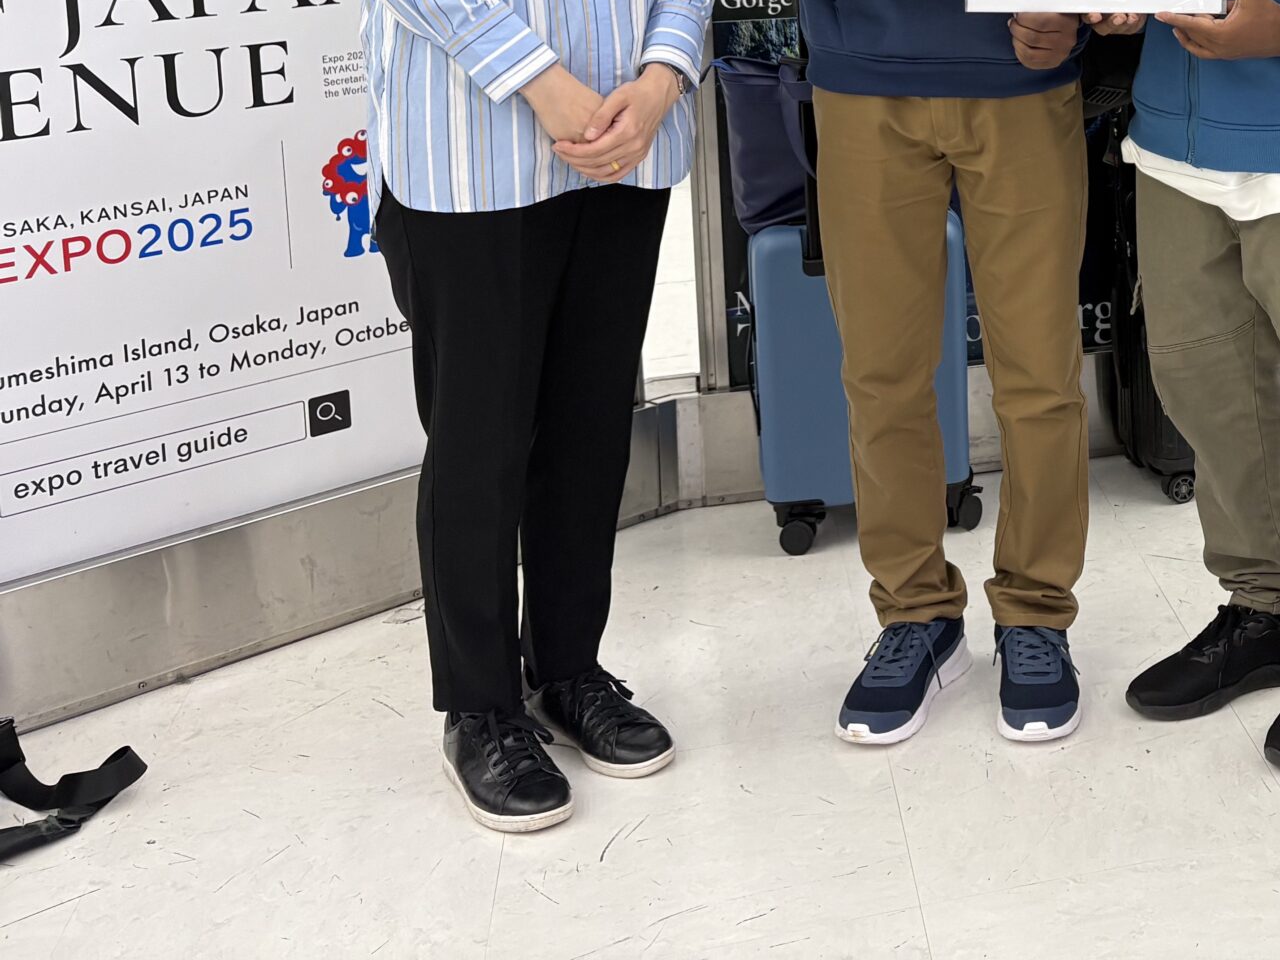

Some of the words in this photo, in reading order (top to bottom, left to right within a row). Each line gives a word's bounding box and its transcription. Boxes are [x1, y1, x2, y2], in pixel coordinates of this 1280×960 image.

[322, 54, 345, 64] Expo
[324, 89, 340, 99] the
[3, 214, 75, 238] SAKA,
[80, 198, 173, 225] KANSAI,
[178, 184, 249, 209] JAPAN
[0, 207, 253, 284] EXPO2025
[123, 328, 199, 363] Island,
[208, 314, 288, 343] Osaka,
[296, 300, 360, 325] Japan
[0, 394, 85, 424] unday,
[94, 370, 152, 404] April
[163, 365, 190, 386] 13
[198, 363, 221, 379] to
[230, 339, 327, 372] Monday,
[13, 469, 83, 499] expo
[92, 442, 168, 479] travel
[176, 426, 249, 463] guide
